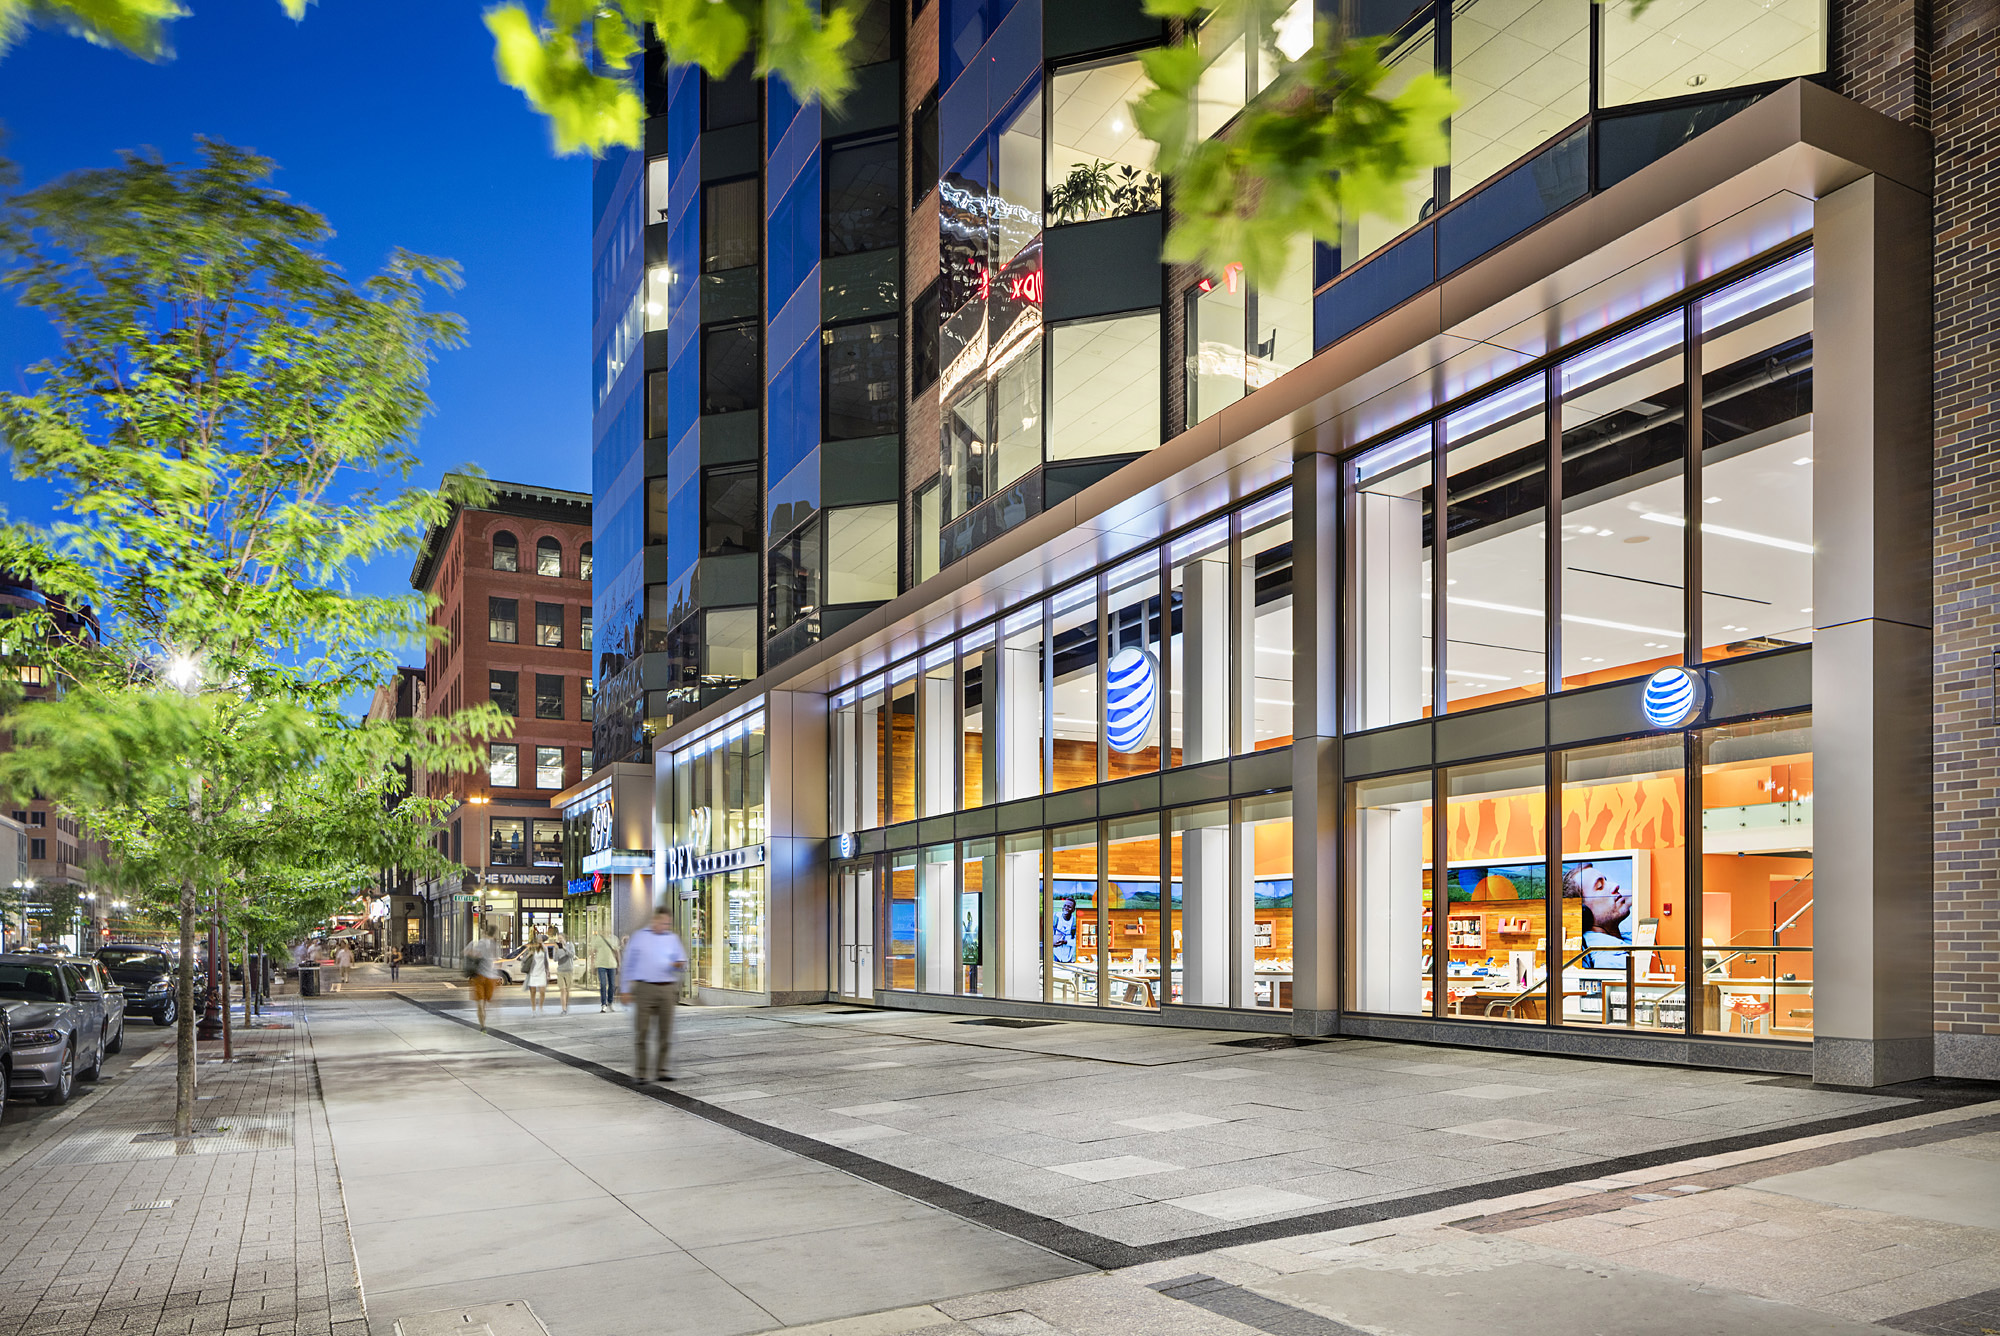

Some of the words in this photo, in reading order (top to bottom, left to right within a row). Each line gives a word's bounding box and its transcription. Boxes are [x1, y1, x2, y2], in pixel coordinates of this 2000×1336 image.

[591, 802, 611, 852] 699
[500, 874, 555, 884] TANNERY
[669, 844, 695, 880] BFX
[697, 851, 742, 872] STUDIO
